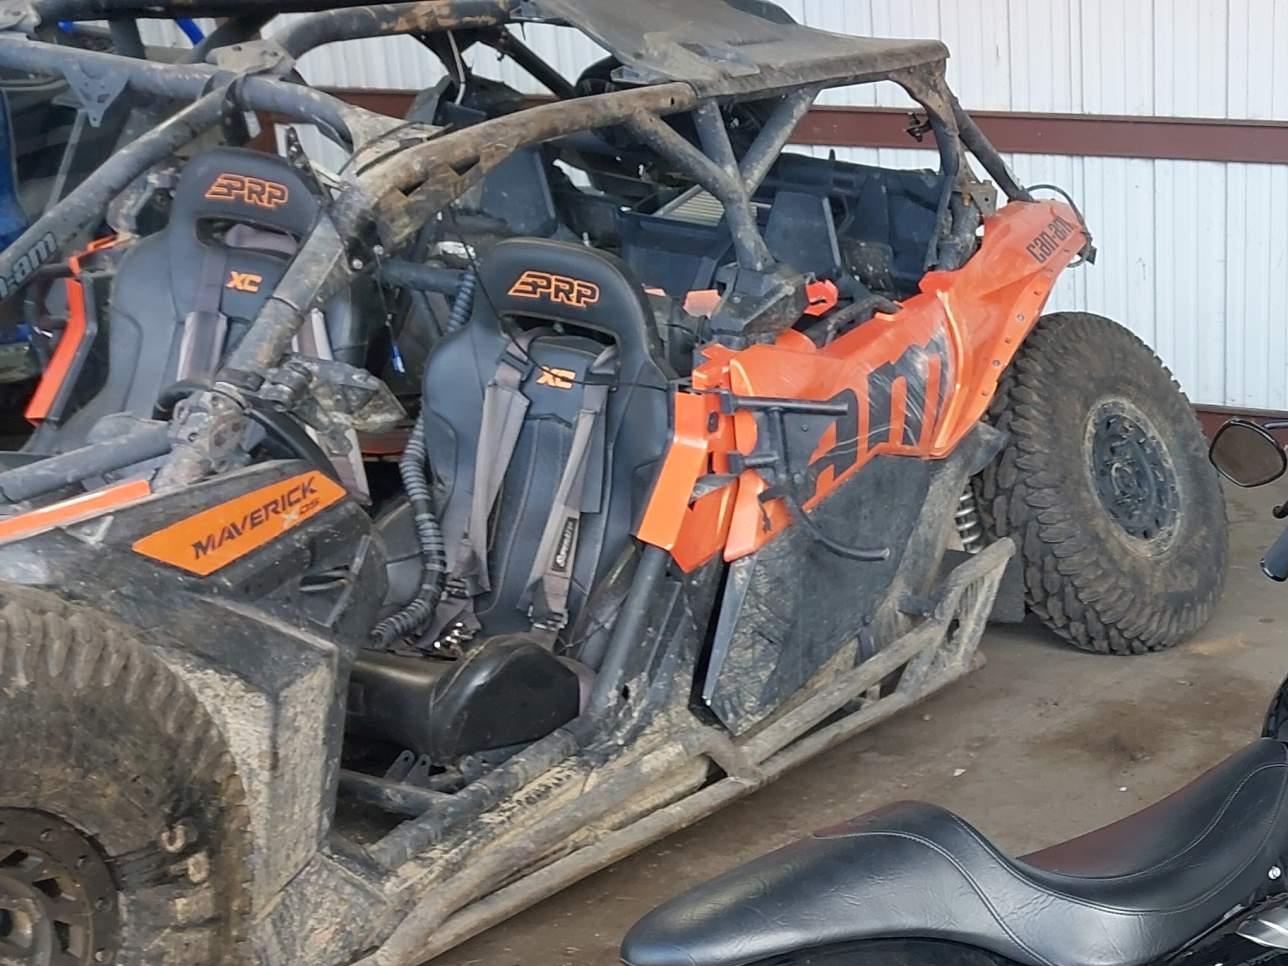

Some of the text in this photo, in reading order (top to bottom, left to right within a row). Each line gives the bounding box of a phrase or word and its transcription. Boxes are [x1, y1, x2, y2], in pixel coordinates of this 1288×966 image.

[204, 173, 289, 208] PRP
[226, 270, 263, 292] XC
[508, 270, 600, 308] PRP
[536, 365, 577, 390] XC
[191, 475, 317, 560] MAVERICK
